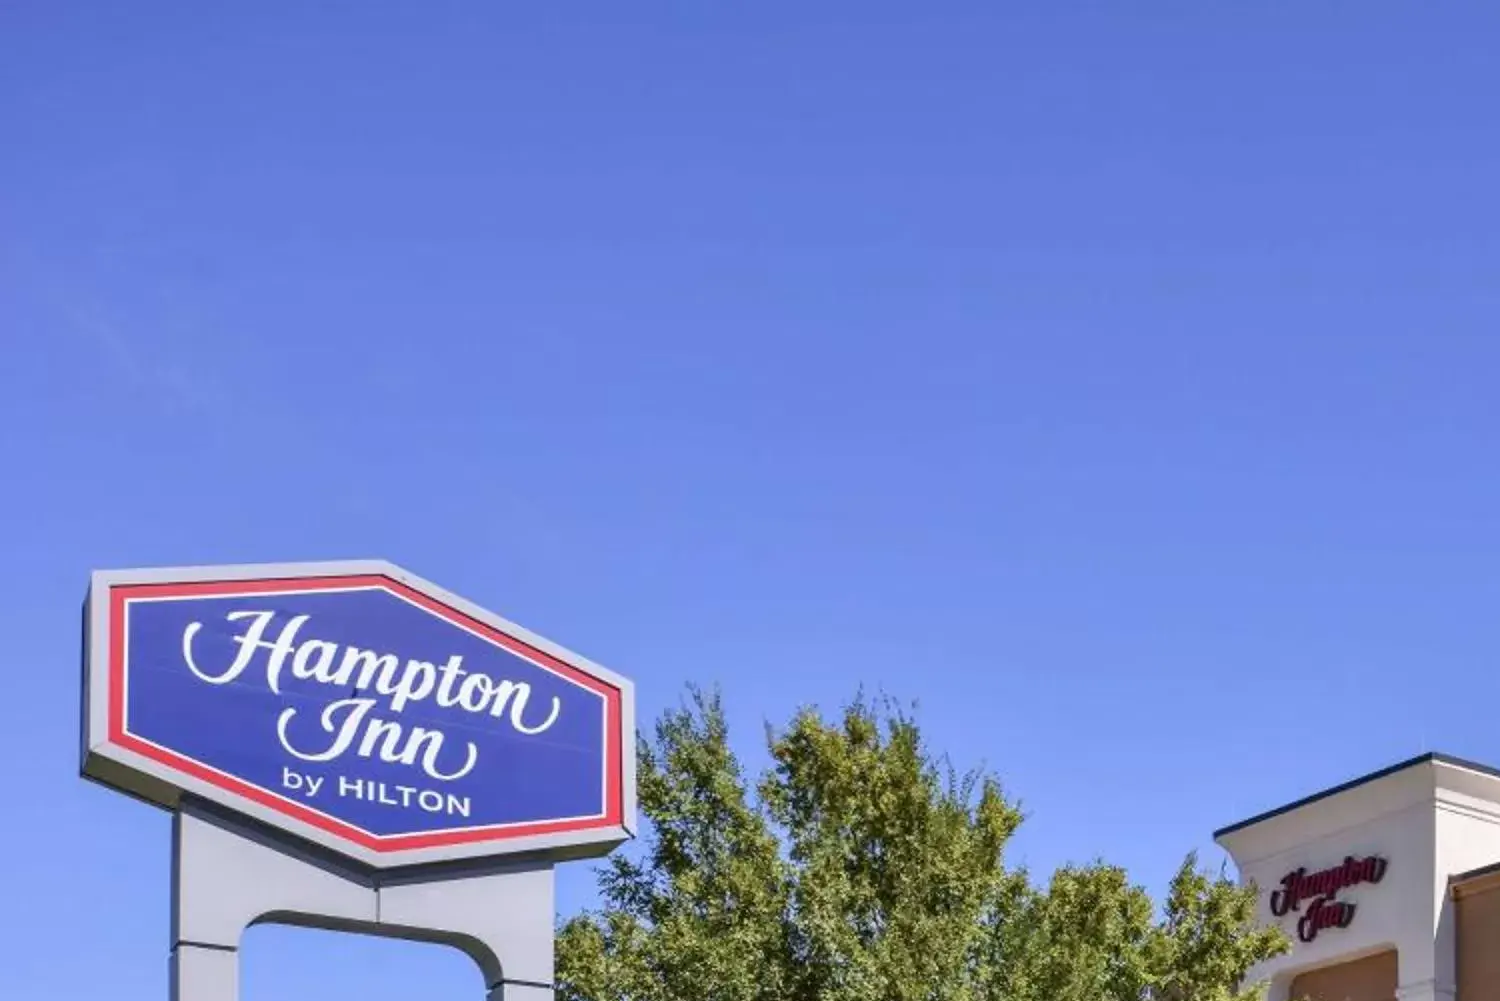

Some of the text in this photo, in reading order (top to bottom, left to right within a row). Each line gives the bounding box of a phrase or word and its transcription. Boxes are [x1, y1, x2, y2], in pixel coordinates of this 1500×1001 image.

[183, 611, 560, 735] Hampton
[277, 699, 478, 781] Inn
[283, 767, 471, 818] by HILTON
[1270, 856, 1388, 916] Hampton
